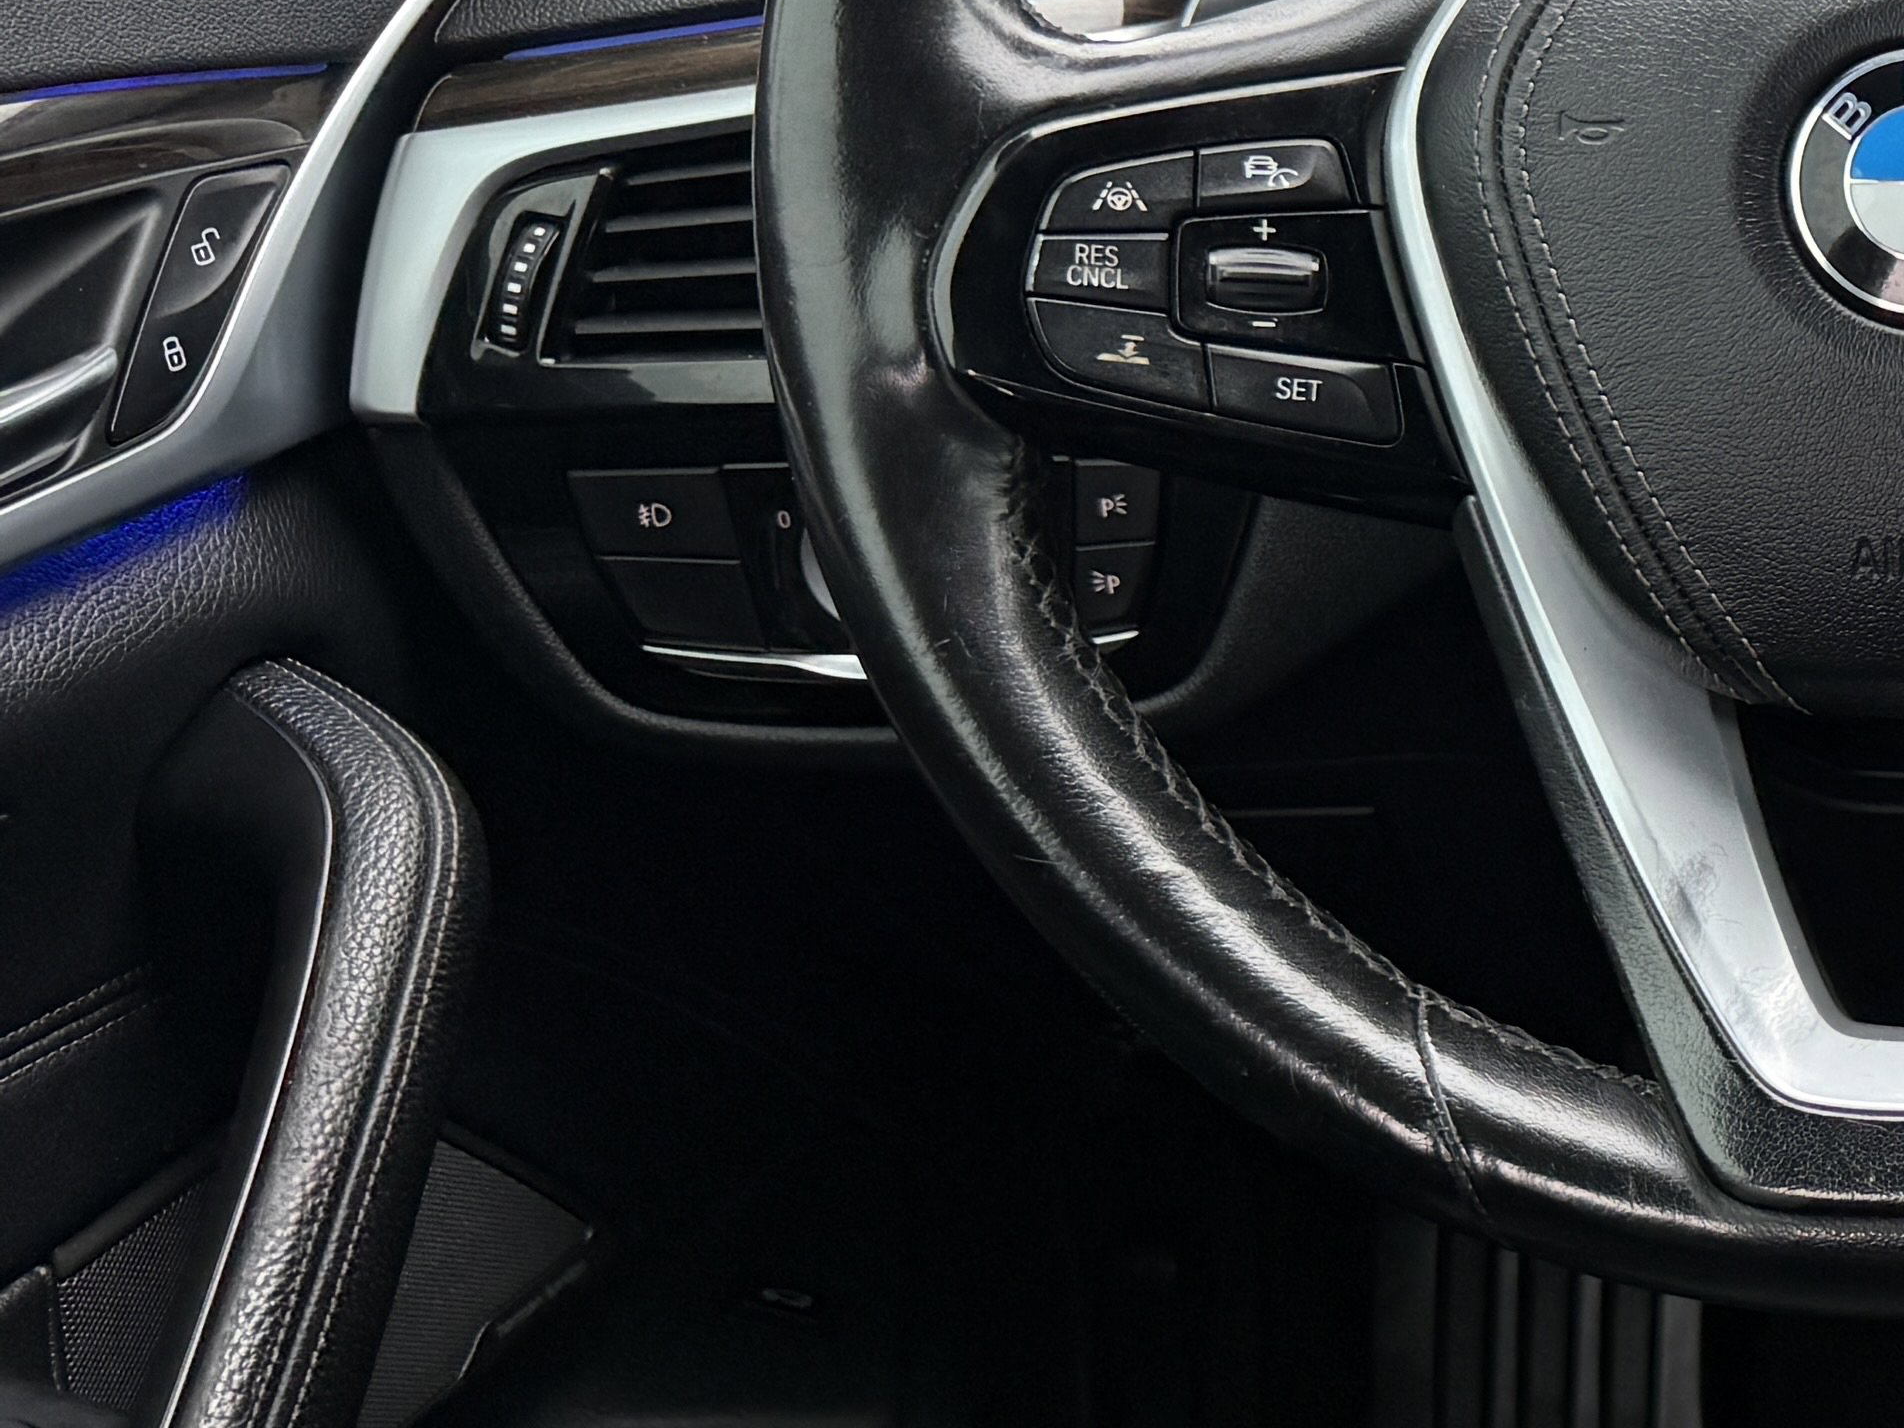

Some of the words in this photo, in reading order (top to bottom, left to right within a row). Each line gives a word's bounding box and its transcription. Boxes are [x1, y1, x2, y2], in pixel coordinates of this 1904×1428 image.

[1074, 243, 1119, 267] RES
[1066, 265, 1129, 290] CNCL
[1275, 376, 1323, 402] SET
